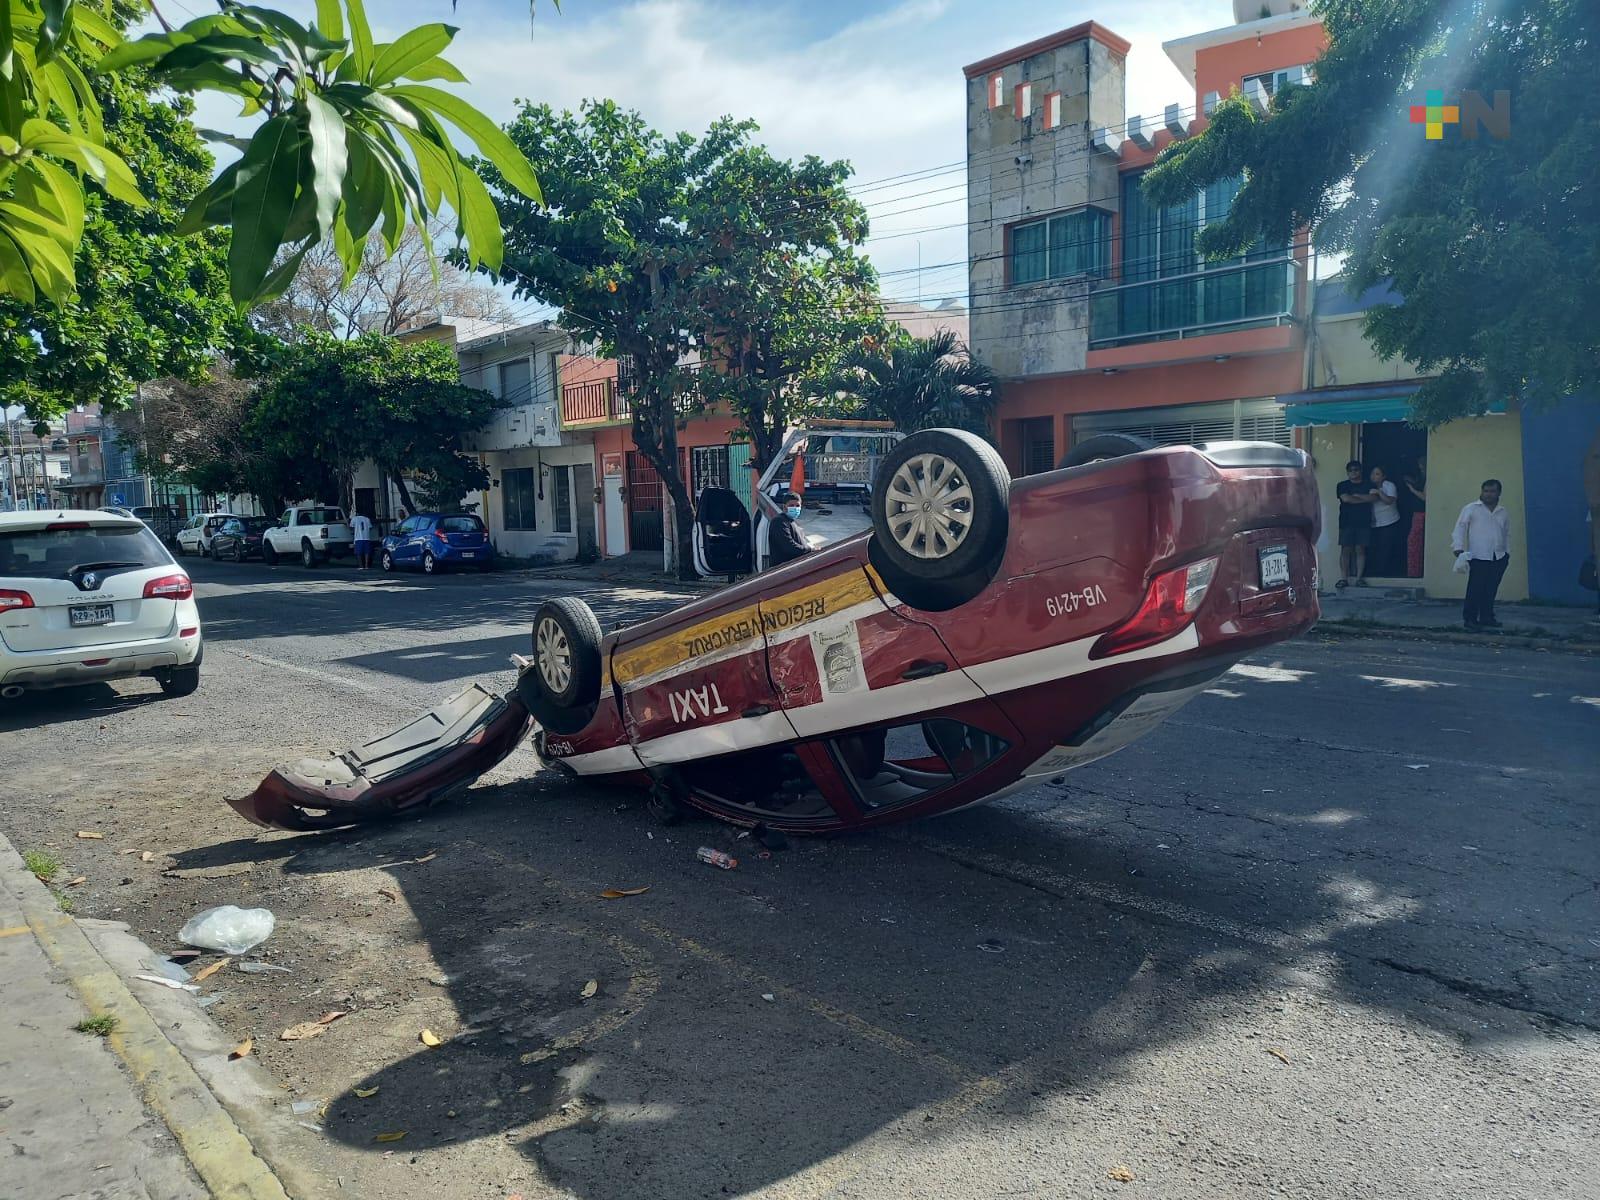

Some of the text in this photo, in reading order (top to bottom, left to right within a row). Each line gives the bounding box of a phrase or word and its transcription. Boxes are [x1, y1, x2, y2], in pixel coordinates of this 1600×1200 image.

[1046, 584, 1107, 617] VB-4219
[684, 597, 826, 659] REGION VERACRUZ
[668, 682, 729, 723] TAXI
